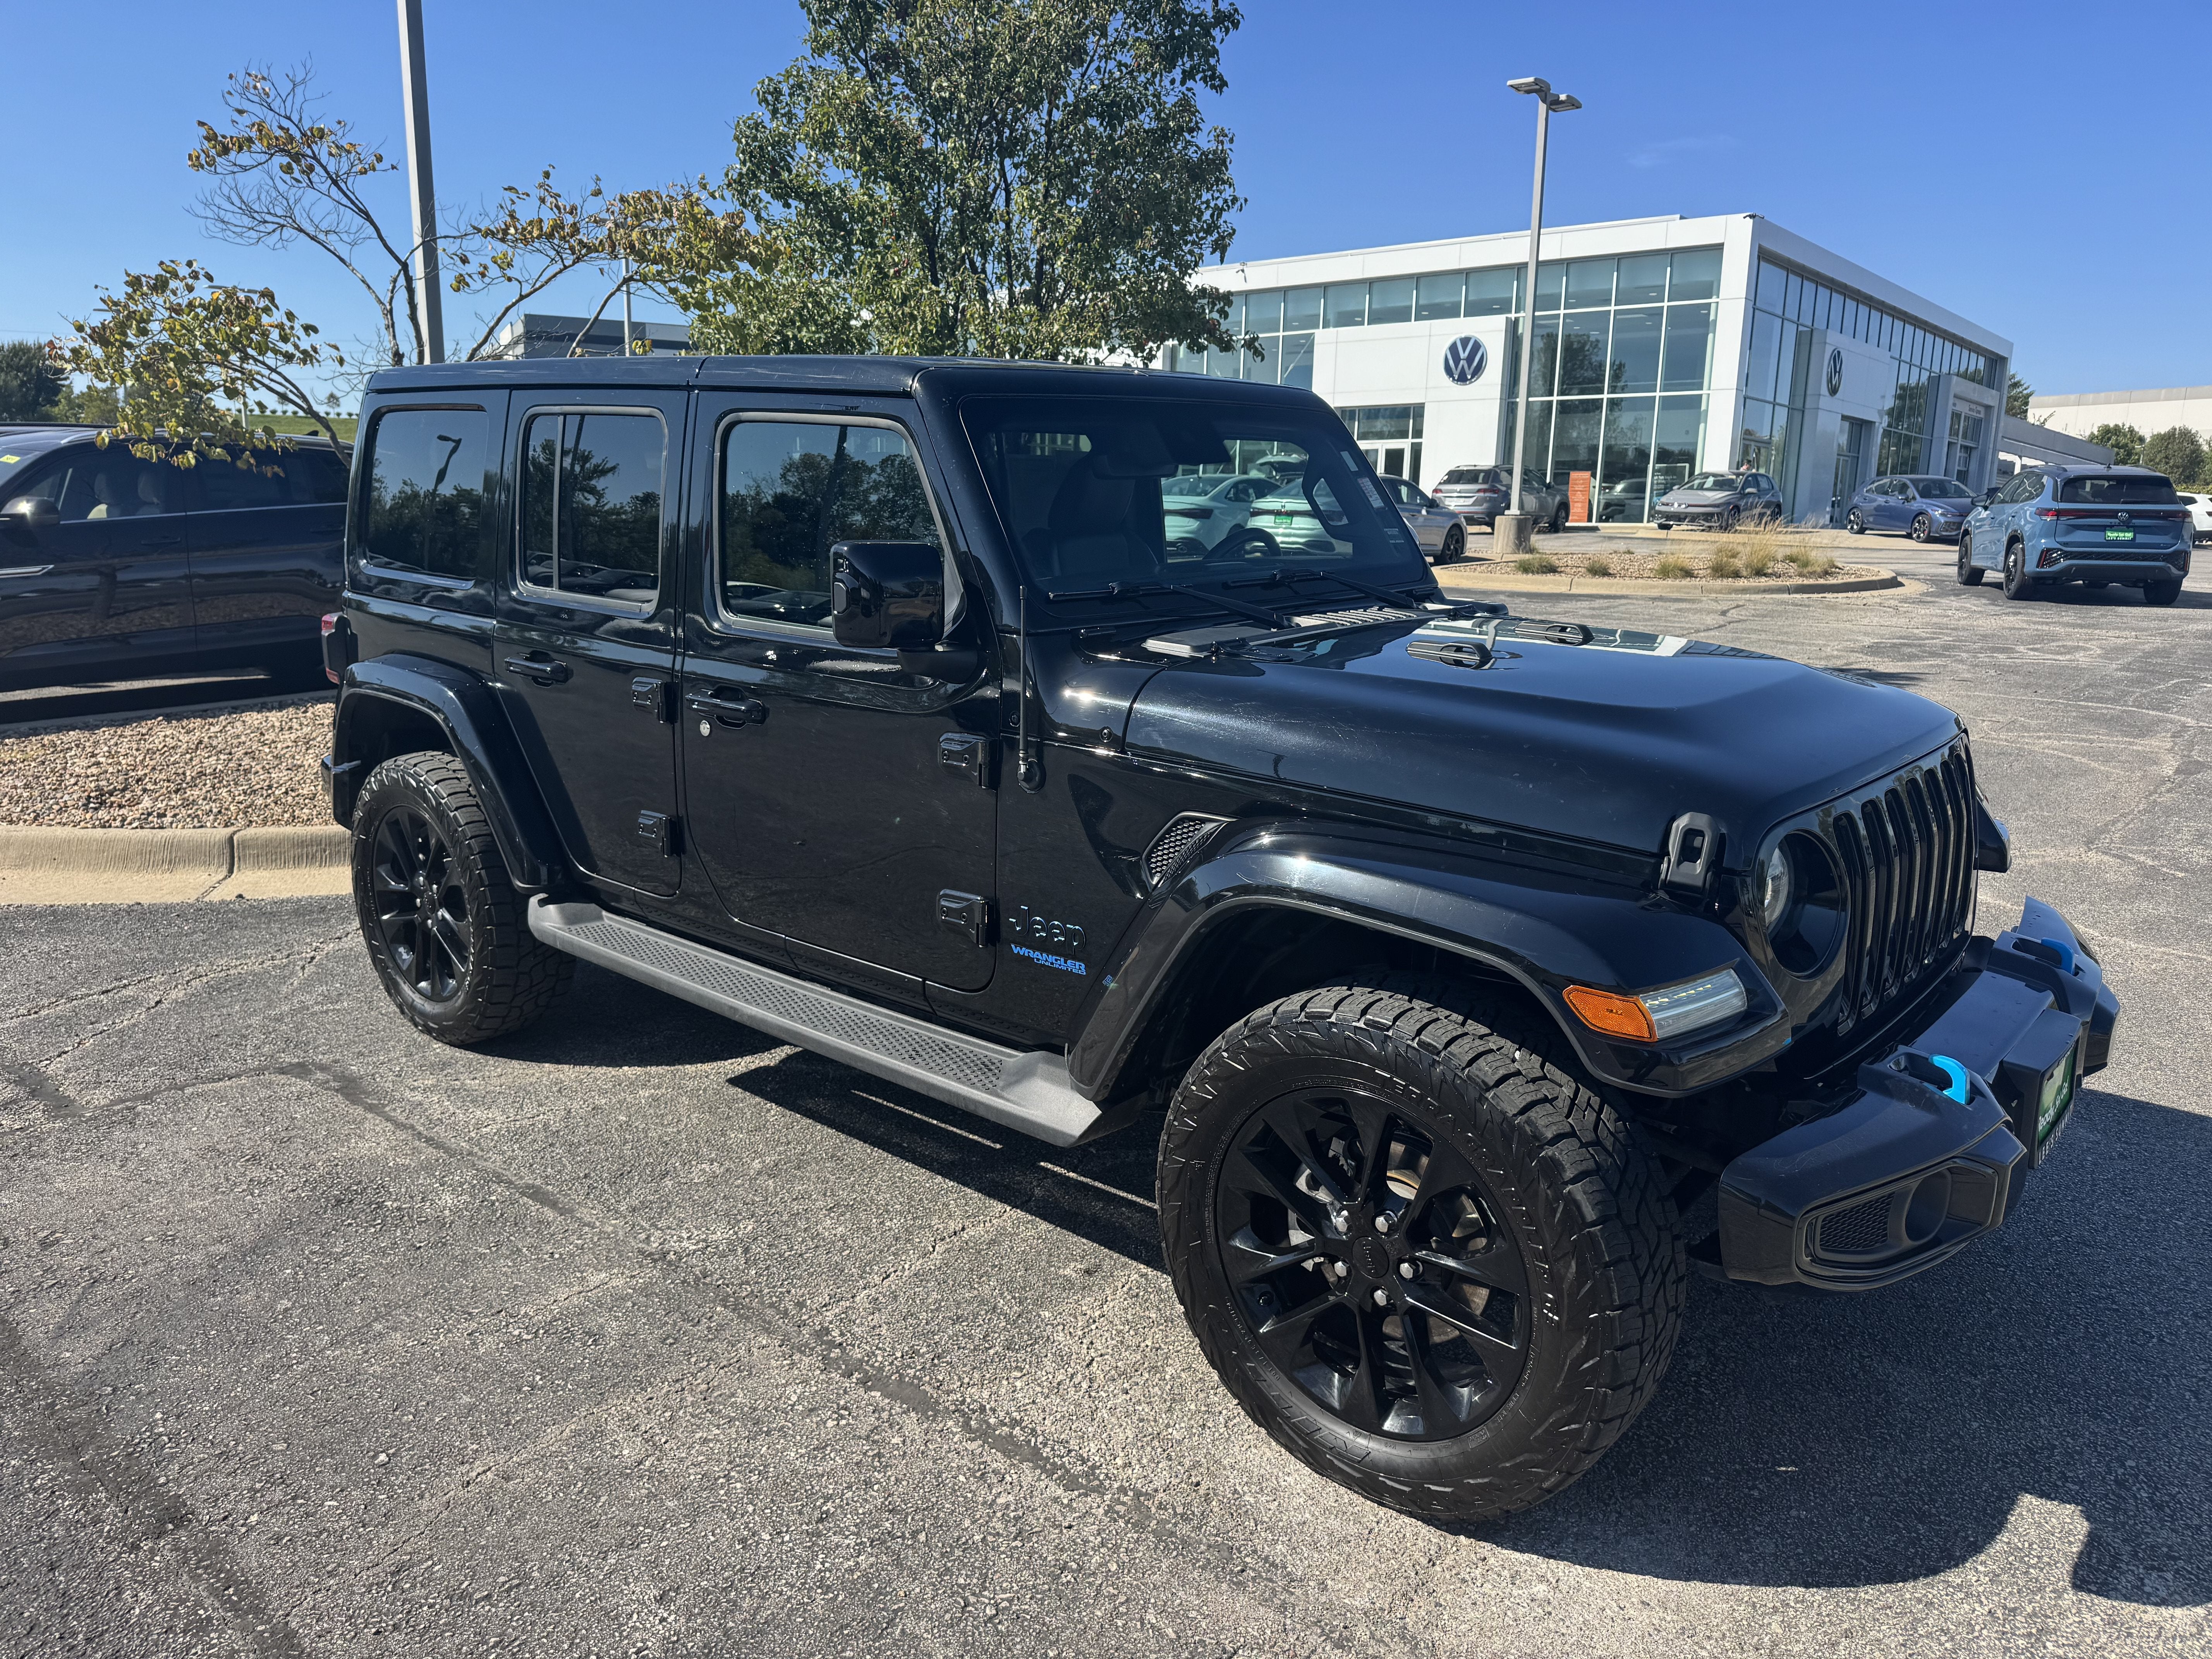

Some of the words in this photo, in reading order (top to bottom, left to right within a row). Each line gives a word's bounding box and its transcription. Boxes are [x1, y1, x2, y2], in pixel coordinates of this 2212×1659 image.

[1444, 335, 1487, 383] VW
[1009, 905, 1085, 955] Jeep
[1011, 944, 1086, 972] WRANGLER
[1034, 958, 1086, 975] UNLIMITED
[2039, 1134, 2053, 1165] LEE'S
[2055, 1103, 2072, 1141] SUMMIT
